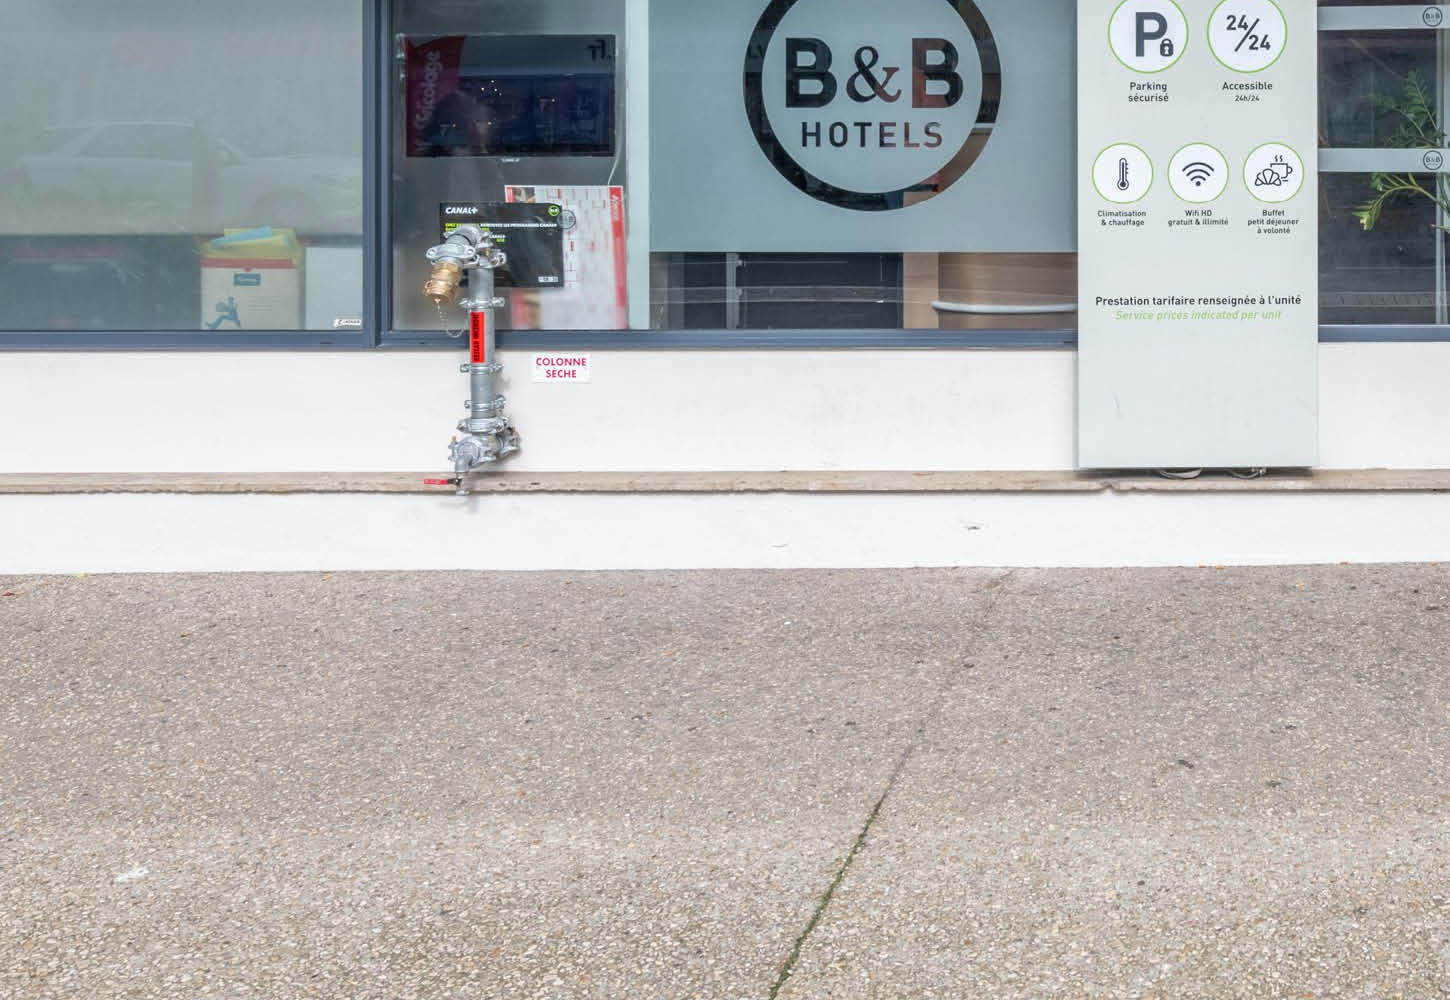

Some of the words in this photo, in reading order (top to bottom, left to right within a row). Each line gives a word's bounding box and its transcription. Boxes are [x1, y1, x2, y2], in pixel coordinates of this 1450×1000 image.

[1136, 12, 1168, 57] P
[785, 37, 963, 108] B&B
[1129, 82, 1167, 92] Parking
[1222, 82, 1273, 90] Accessible
[1128, 93, 1169, 102] sécurisé
[1234, 94, 1260, 102] 24h/24
[801, 121, 943, 149] HOTELS
[445, 206, 479, 215] CANAL+
[1097, 209, 1147, 217] Climatisation
[1184, 209, 1199, 217] Wifi
[1201, 209, 1212, 217] HD
[1262, 209, 1285, 217] Buffet
[1108, 219, 1145, 227] chauffage
[1168, 219, 1193, 227] gratuit
[1247, 219, 1265, 227] petit
[1266, 218, 1299, 227] déjeuner
[1095, 296, 1150, 306] Prestation
[1152, 296, 1195, 306] tarifaire
[1198, 295, 1257, 307] renseignée
[1259, 295, 1265, 305] à
[1268, 295, 1301, 305] l'unité
[1115, 310, 1154, 320] Service
[1156, 310, 1189, 322] prices
[1191, 310, 1239, 320] indicated
[1240, 311, 1258, 322] per
[1261, 310, 1282, 320] unit
[536, 357, 587, 367] COLONNE
[545, 367, 577, 378] SÈCHE
